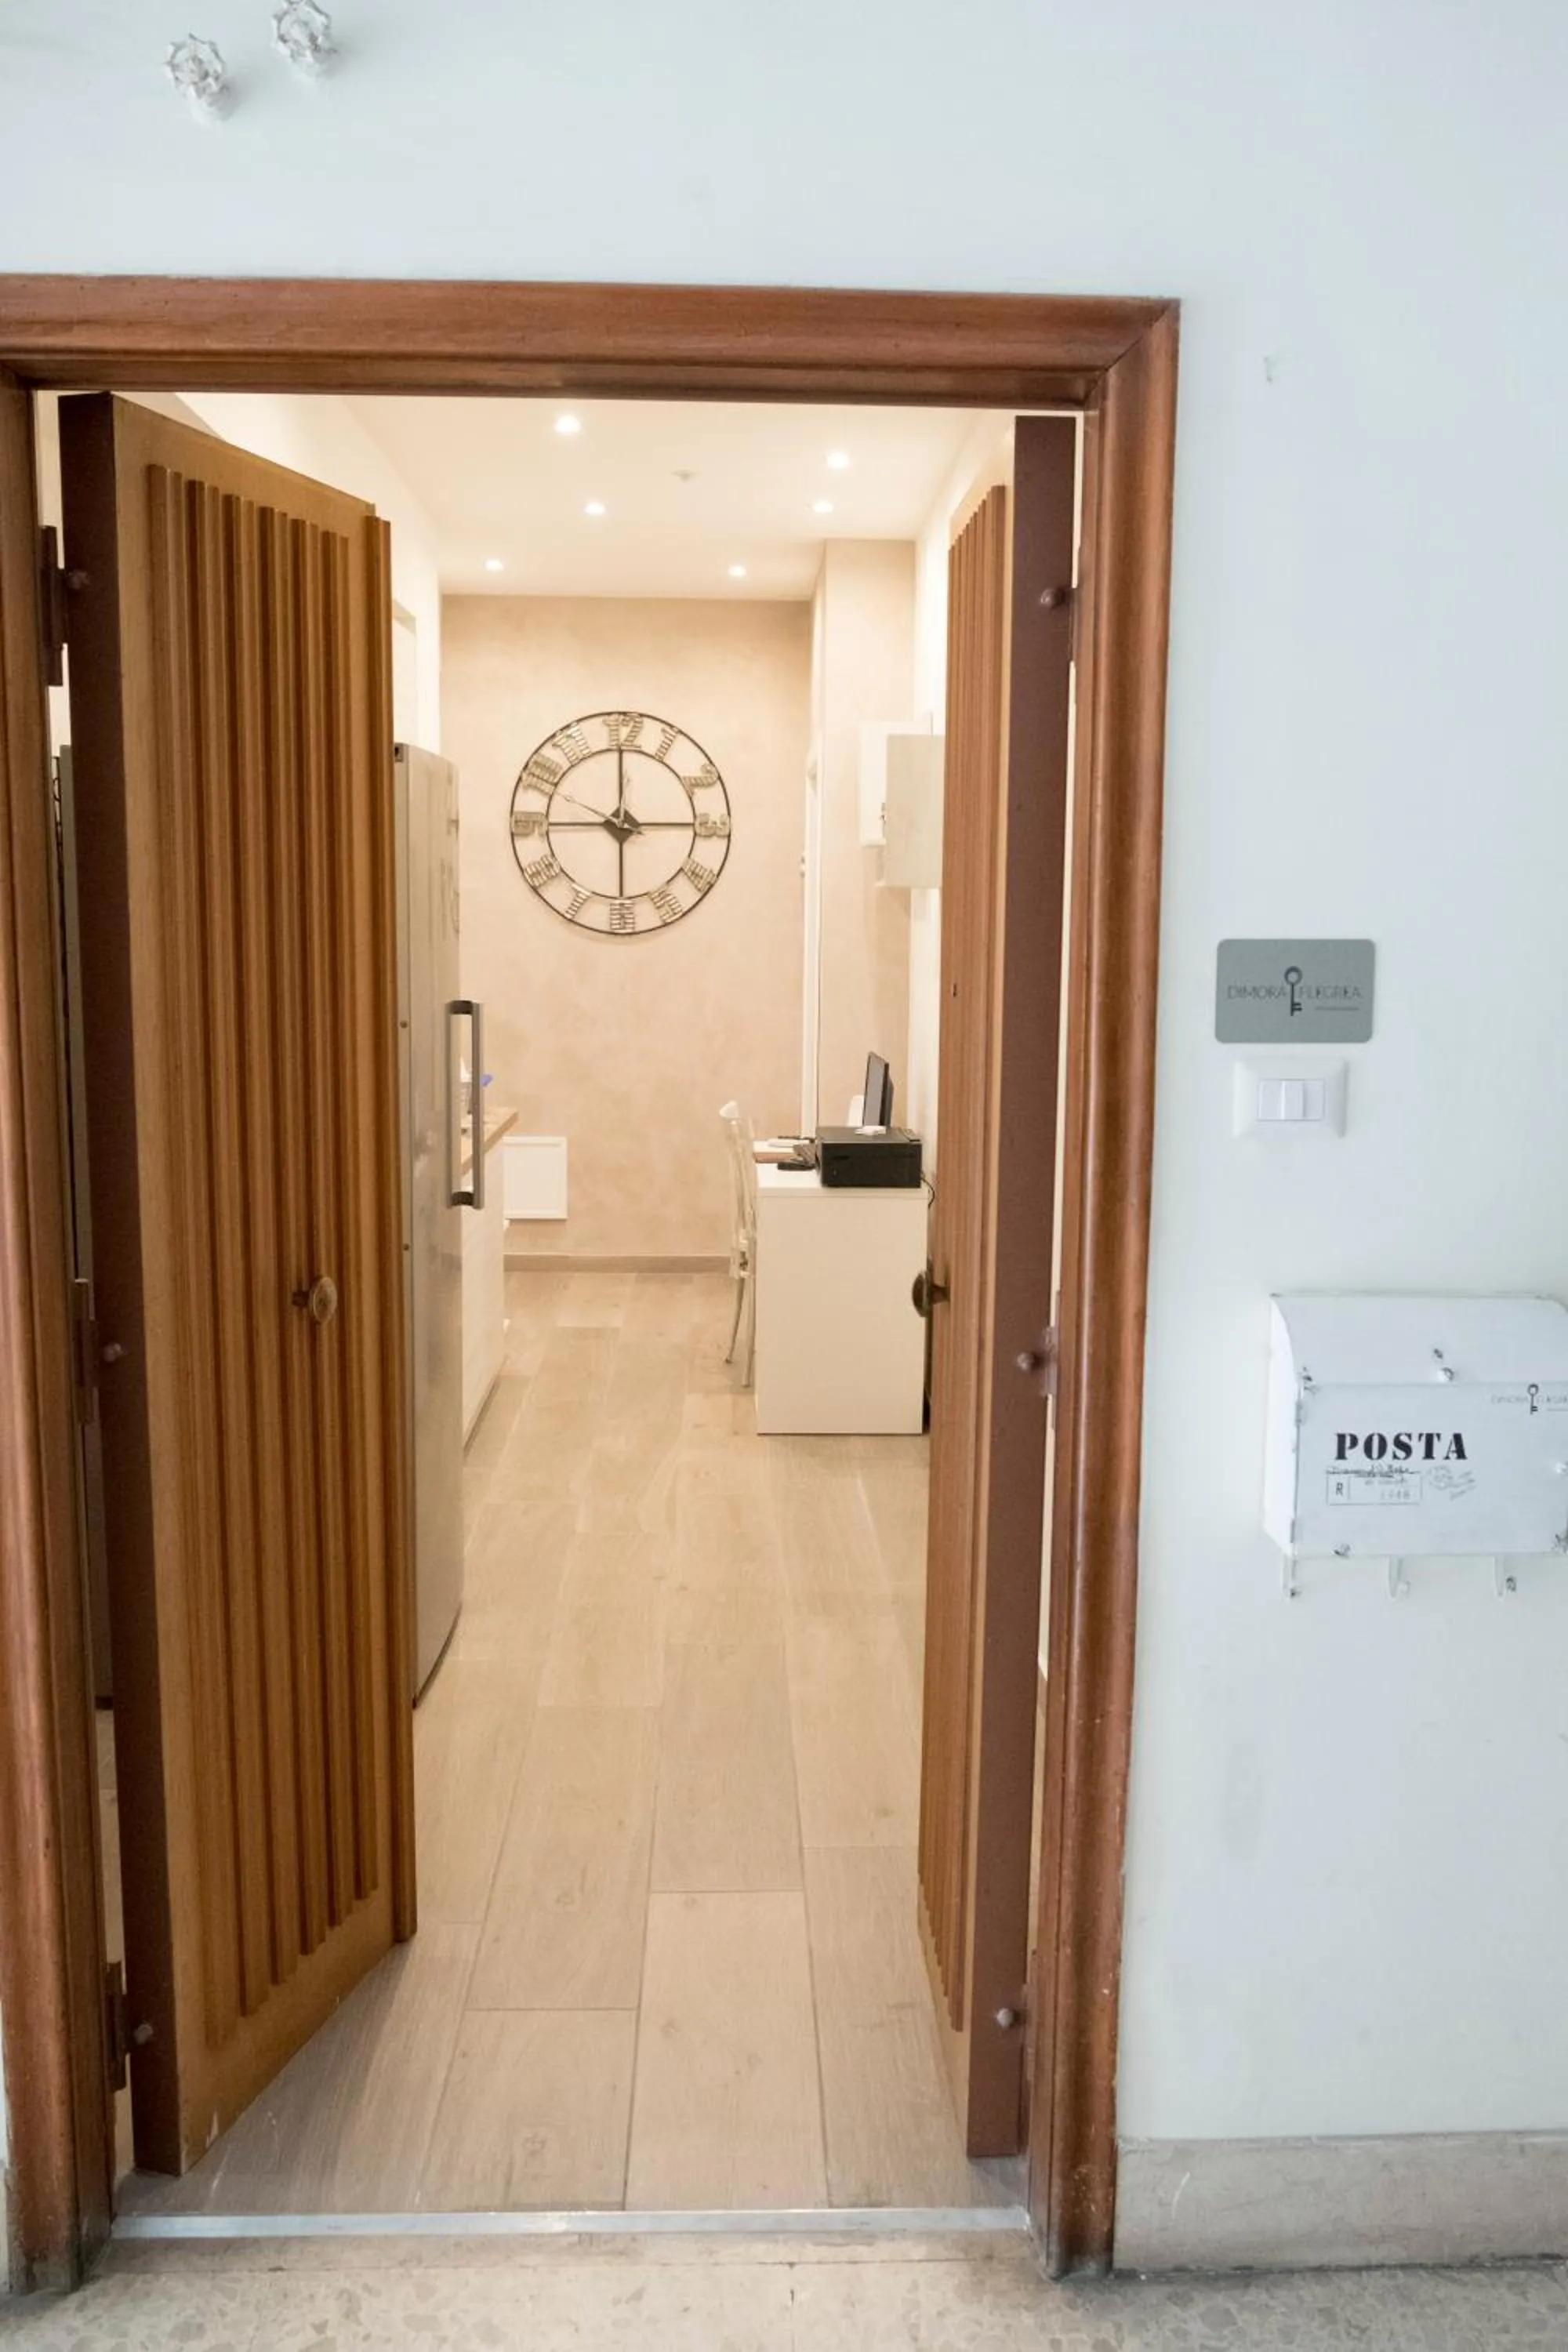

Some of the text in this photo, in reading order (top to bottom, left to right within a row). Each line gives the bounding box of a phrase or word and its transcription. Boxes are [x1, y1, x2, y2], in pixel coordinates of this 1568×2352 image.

[602, 713, 644, 748] 12
[695, 812, 730, 838] 3
[1227, 985, 1287, 999] DIMORA
[1334, 1432, 1468, 1461] POSTA
